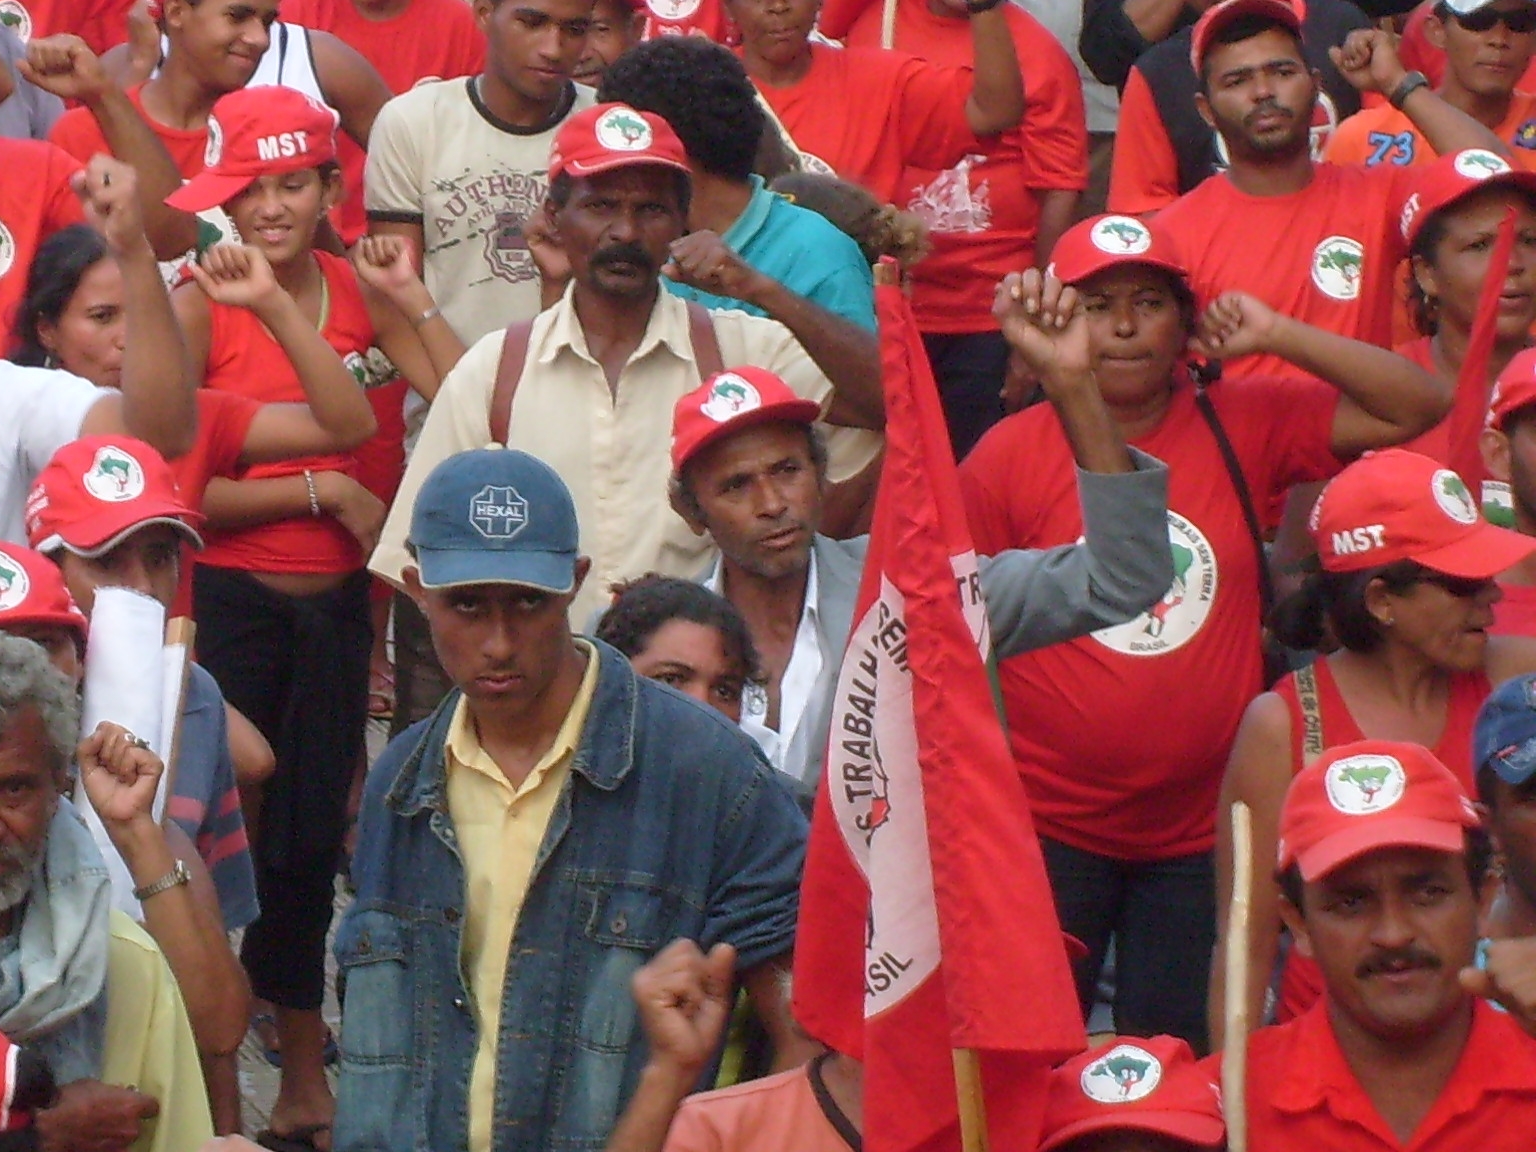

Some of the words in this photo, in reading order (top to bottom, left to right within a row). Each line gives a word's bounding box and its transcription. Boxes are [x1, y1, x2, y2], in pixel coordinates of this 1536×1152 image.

[256, 131, 308, 161] MST
[1366, 130, 1414, 168] 73
[476, 504, 524, 518] HEXAL
[1332, 524, 1386, 556] MST
[1200, 566, 1214, 603] TERRA
[1129, 641, 1170, 652] BRASIL
